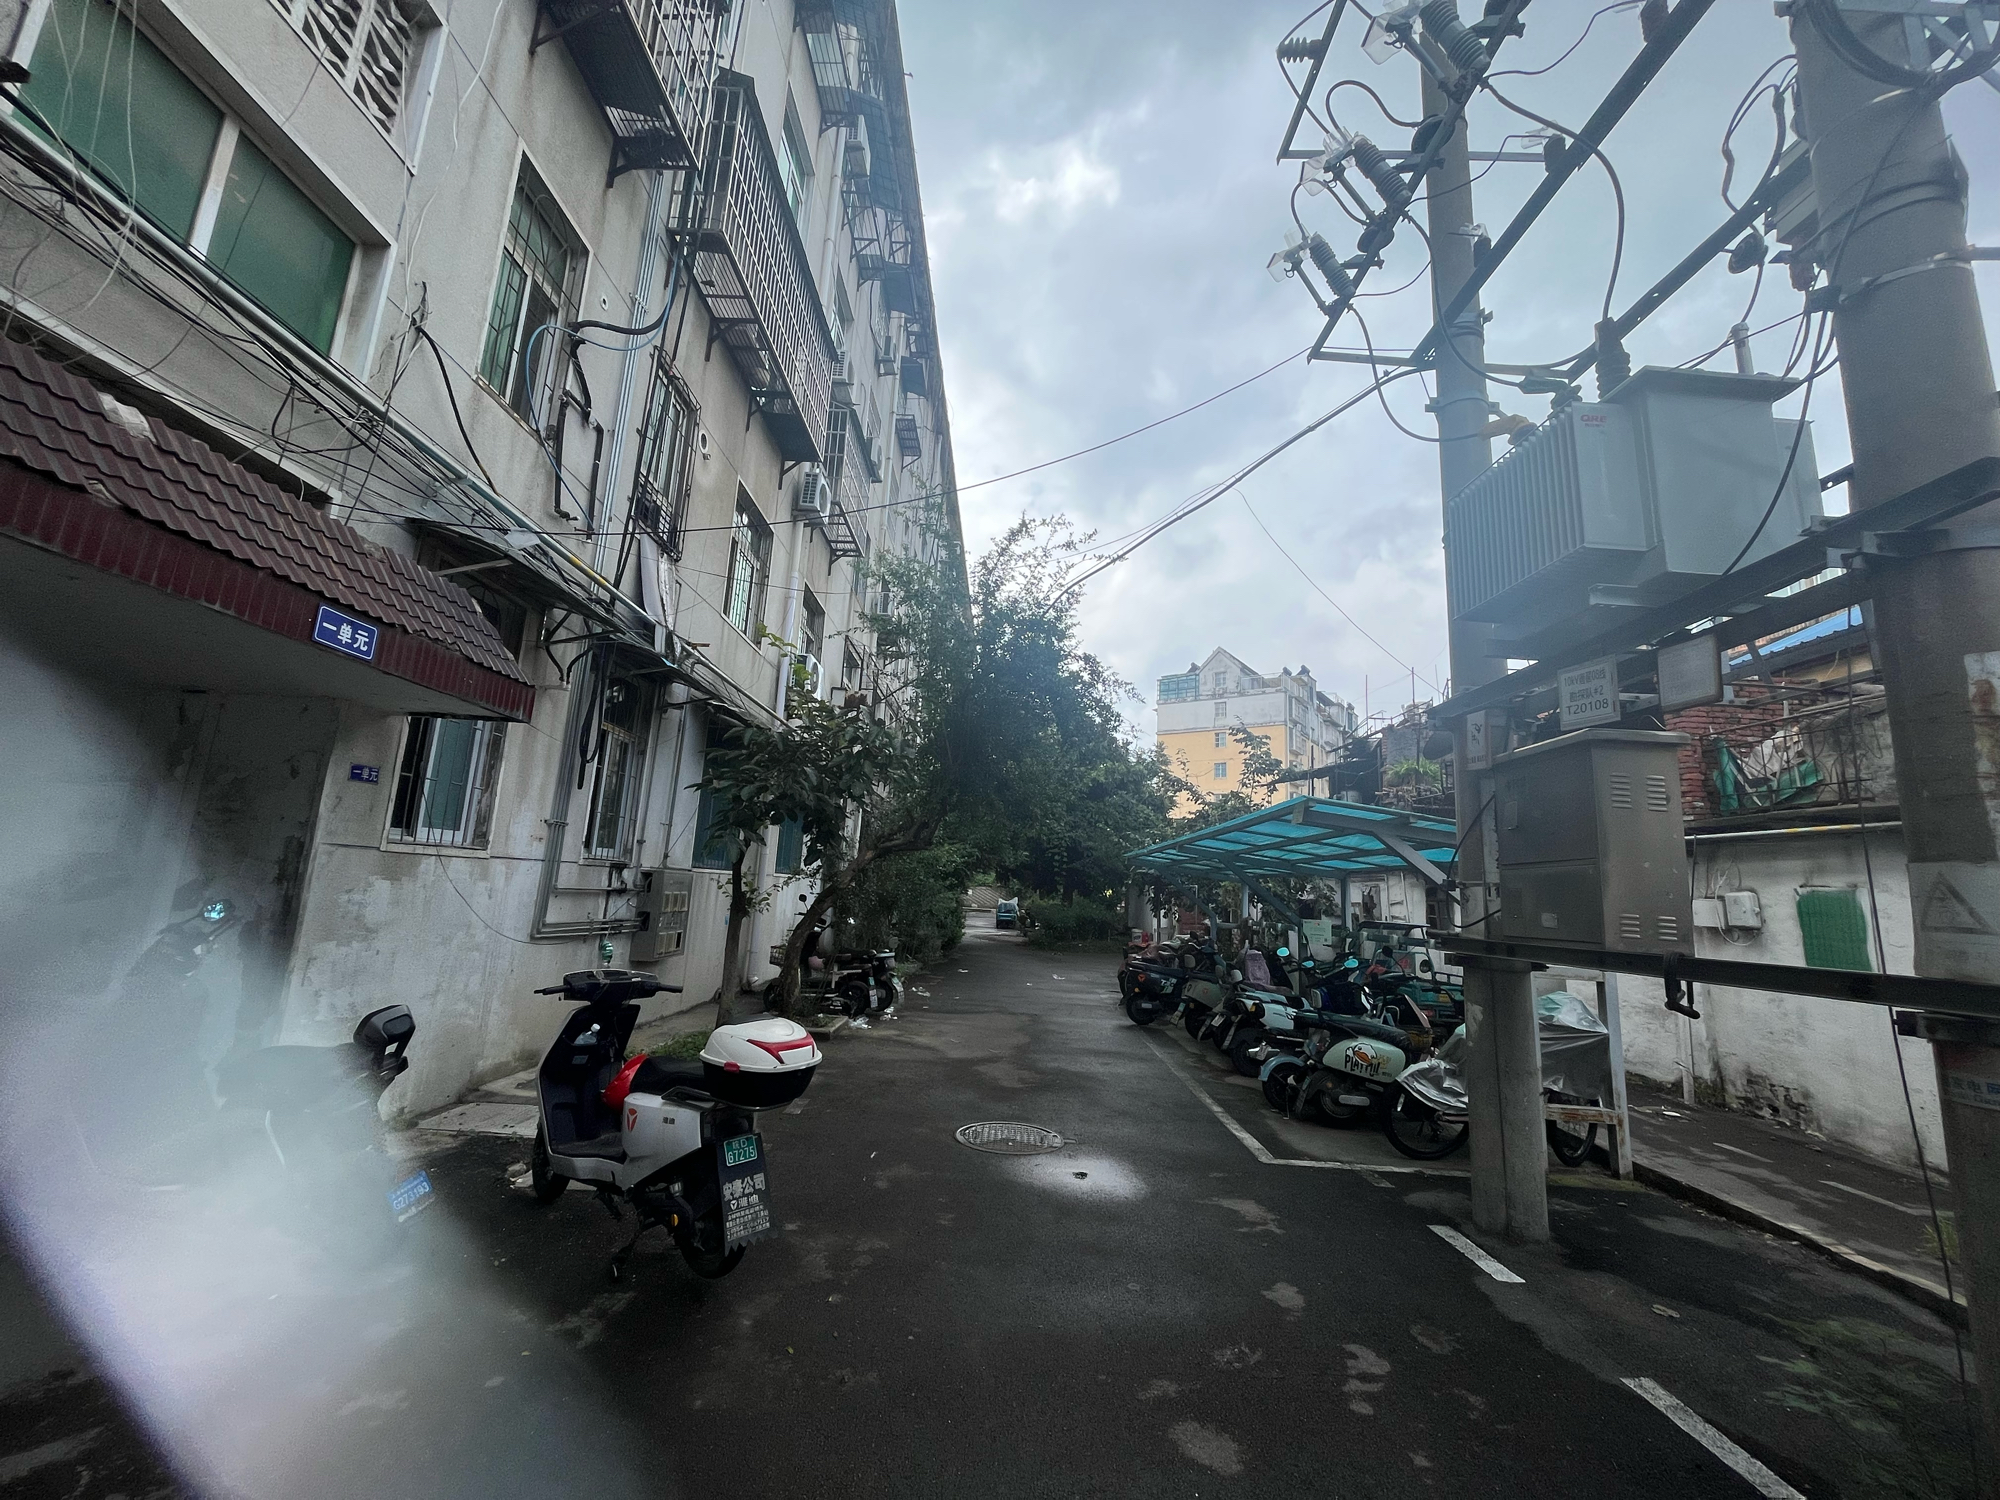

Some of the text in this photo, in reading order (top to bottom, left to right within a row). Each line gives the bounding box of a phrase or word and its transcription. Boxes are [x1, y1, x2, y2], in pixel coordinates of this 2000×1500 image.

[322, 622, 369, 652] 一单元
[1565, 698, 1609, 716] T20108
[352, 767, 378, 781] 一单元
[727, 1148, 755, 1163] 67275
[393, 1182, 430, 1210] G273193
